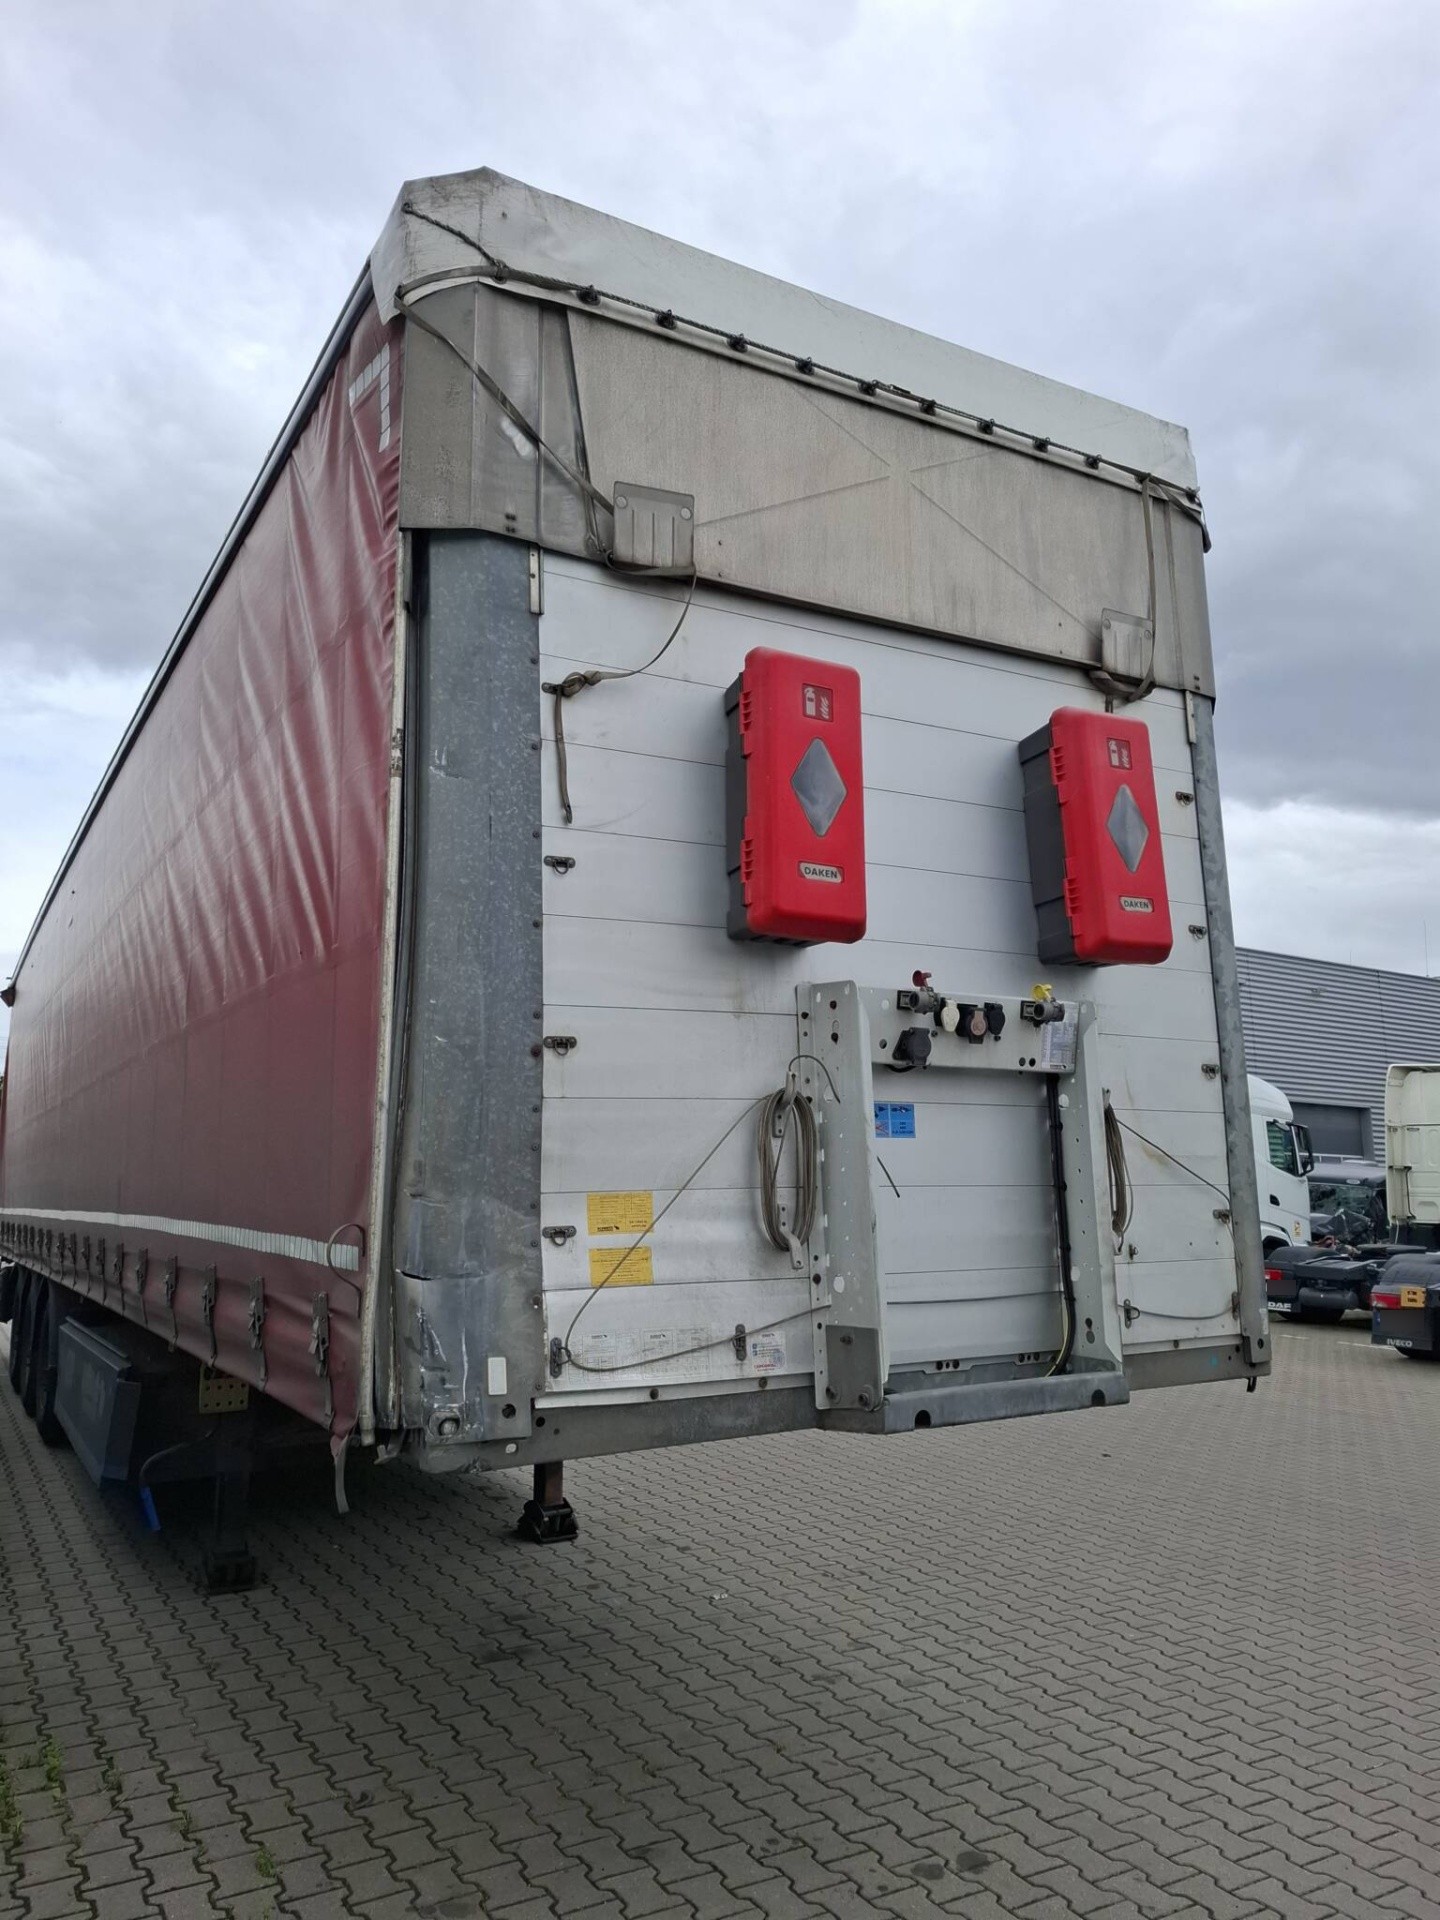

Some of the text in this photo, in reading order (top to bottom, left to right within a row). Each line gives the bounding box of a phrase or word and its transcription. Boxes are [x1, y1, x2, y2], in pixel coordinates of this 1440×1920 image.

[804, 866, 838, 879] DAKEN
[1123, 900, 1149, 909] DAKEN
[1268, 1301, 1292, 1309] DAF
[1387, 1338, 1413, 1347] IVECO
